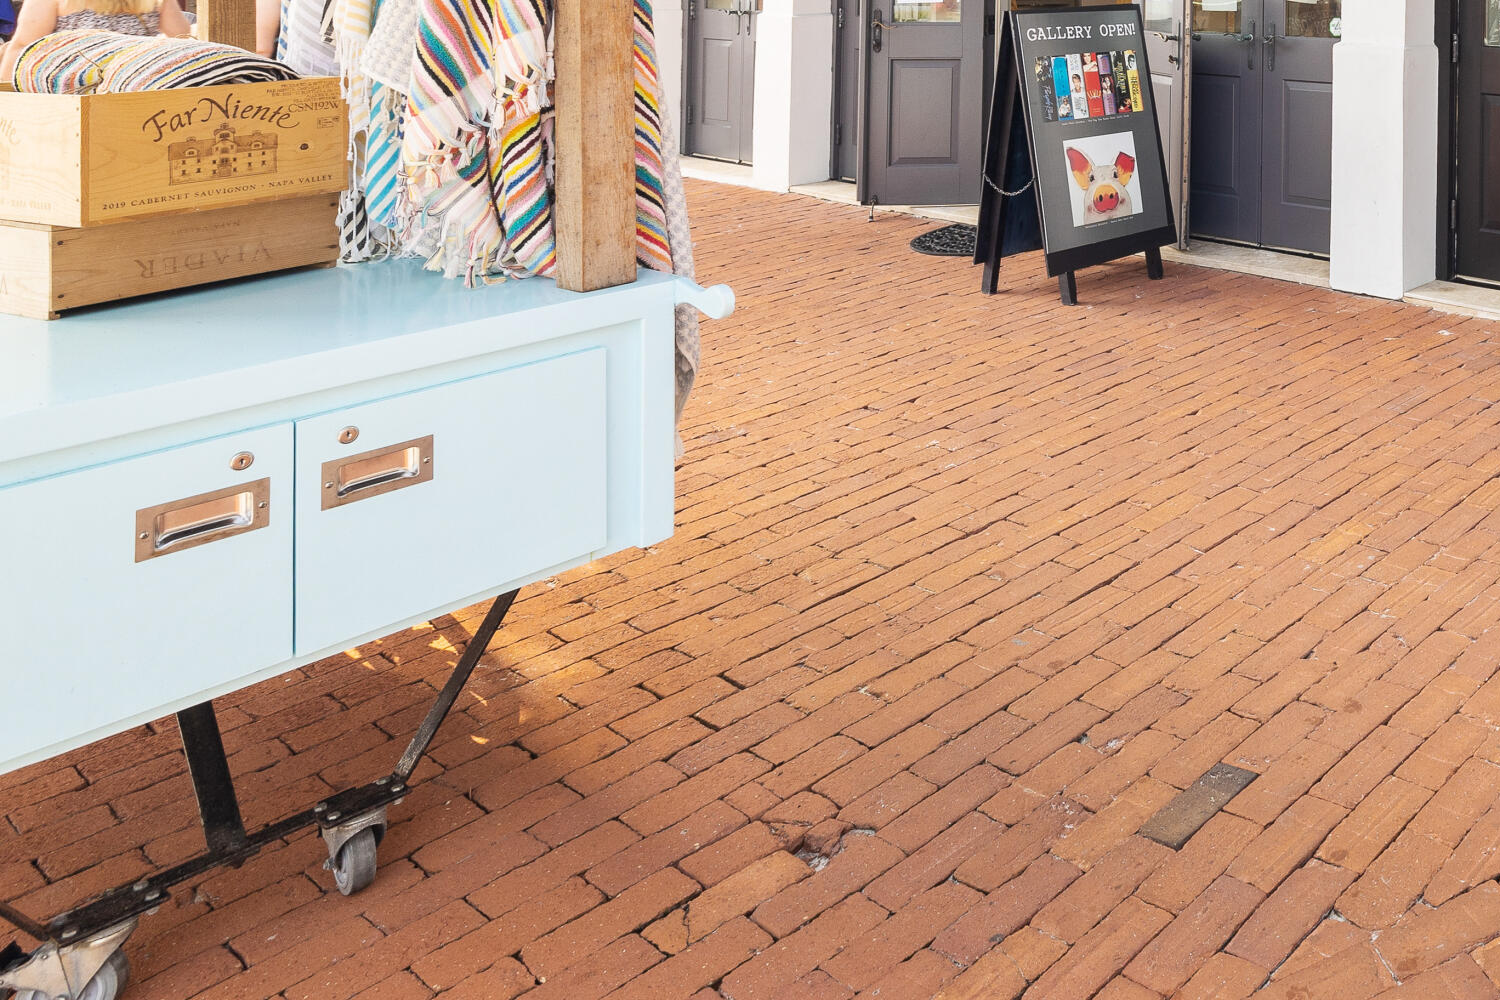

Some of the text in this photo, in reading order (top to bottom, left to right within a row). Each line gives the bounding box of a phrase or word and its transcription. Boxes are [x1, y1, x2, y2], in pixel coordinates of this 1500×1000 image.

[1026, 23, 1137, 42] GALLERY OPEN!
[142, 93, 301, 143] Far Niente
[288, 101, 338, 112] CSN192W
[102, 174, 334, 210] 2019 CABERNET SAUVIGNON NAPA VALLEY
[134, 240, 273, 279] VIADER
